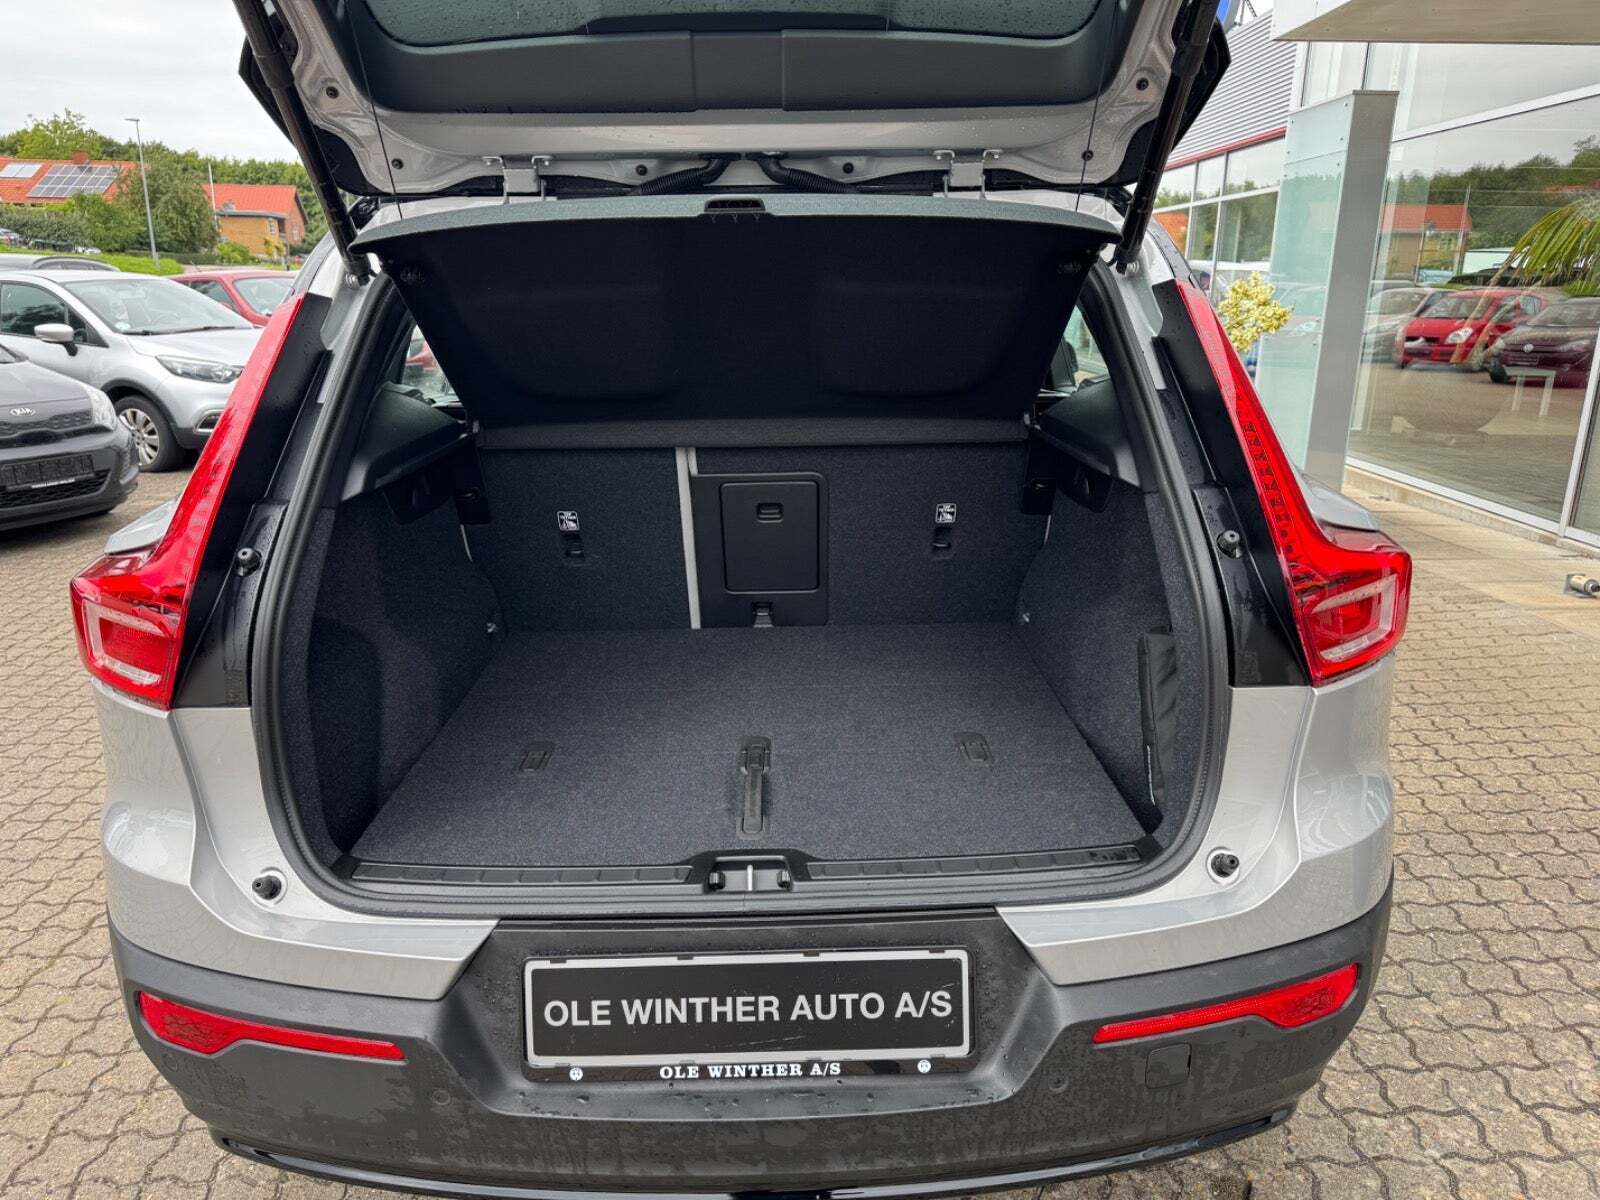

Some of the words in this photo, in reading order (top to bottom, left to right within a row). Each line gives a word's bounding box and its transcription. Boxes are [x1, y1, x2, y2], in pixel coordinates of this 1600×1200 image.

[543, 999, 612, 1027] OLE
[621, 996, 780, 1025] WINTHER
[790, 991, 885, 1021] AUTO
[894, 989, 954, 1018] A/S
[659, 1066, 700, 1079] OLE
[706, 1064, 803, 1078] WINTHER
[809, 1063, 841, 1077] A/S
